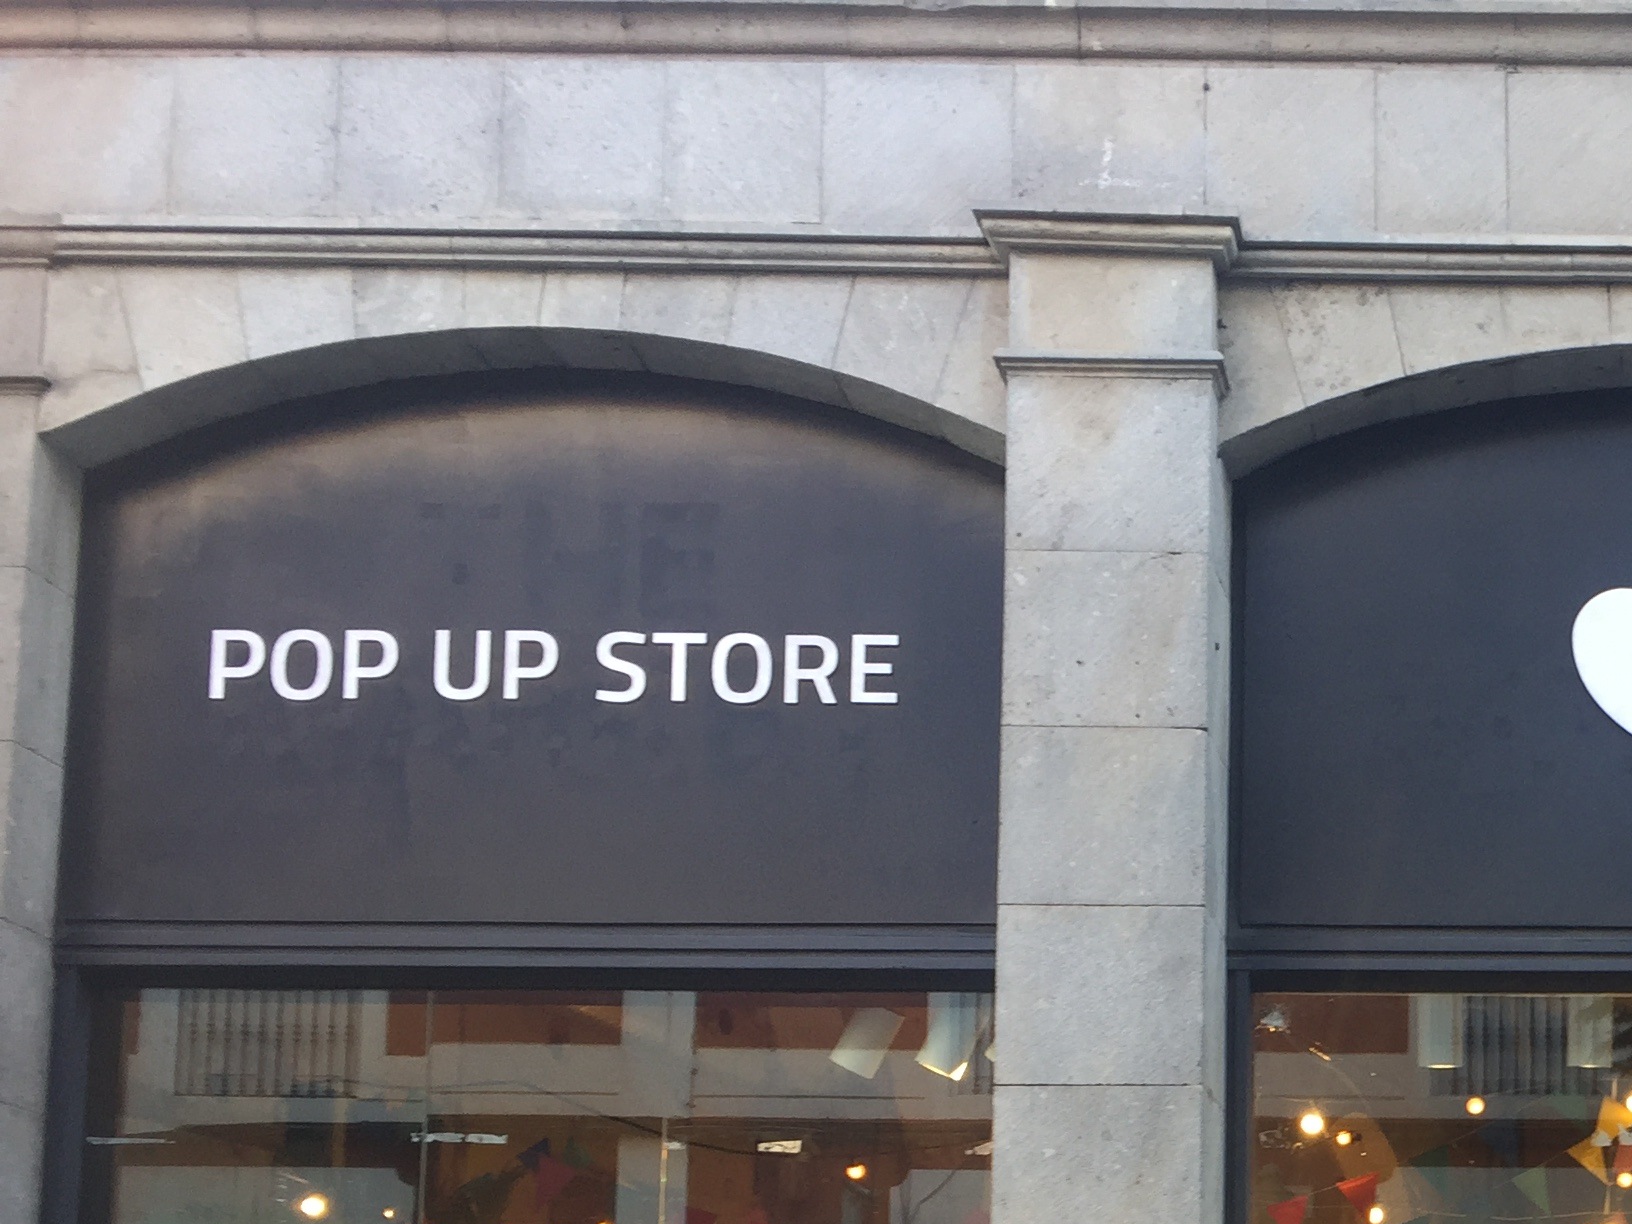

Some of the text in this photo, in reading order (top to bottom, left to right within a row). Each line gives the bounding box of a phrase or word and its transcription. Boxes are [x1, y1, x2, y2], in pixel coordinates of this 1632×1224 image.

[208, 628, 900, 704] POP UP STORE
